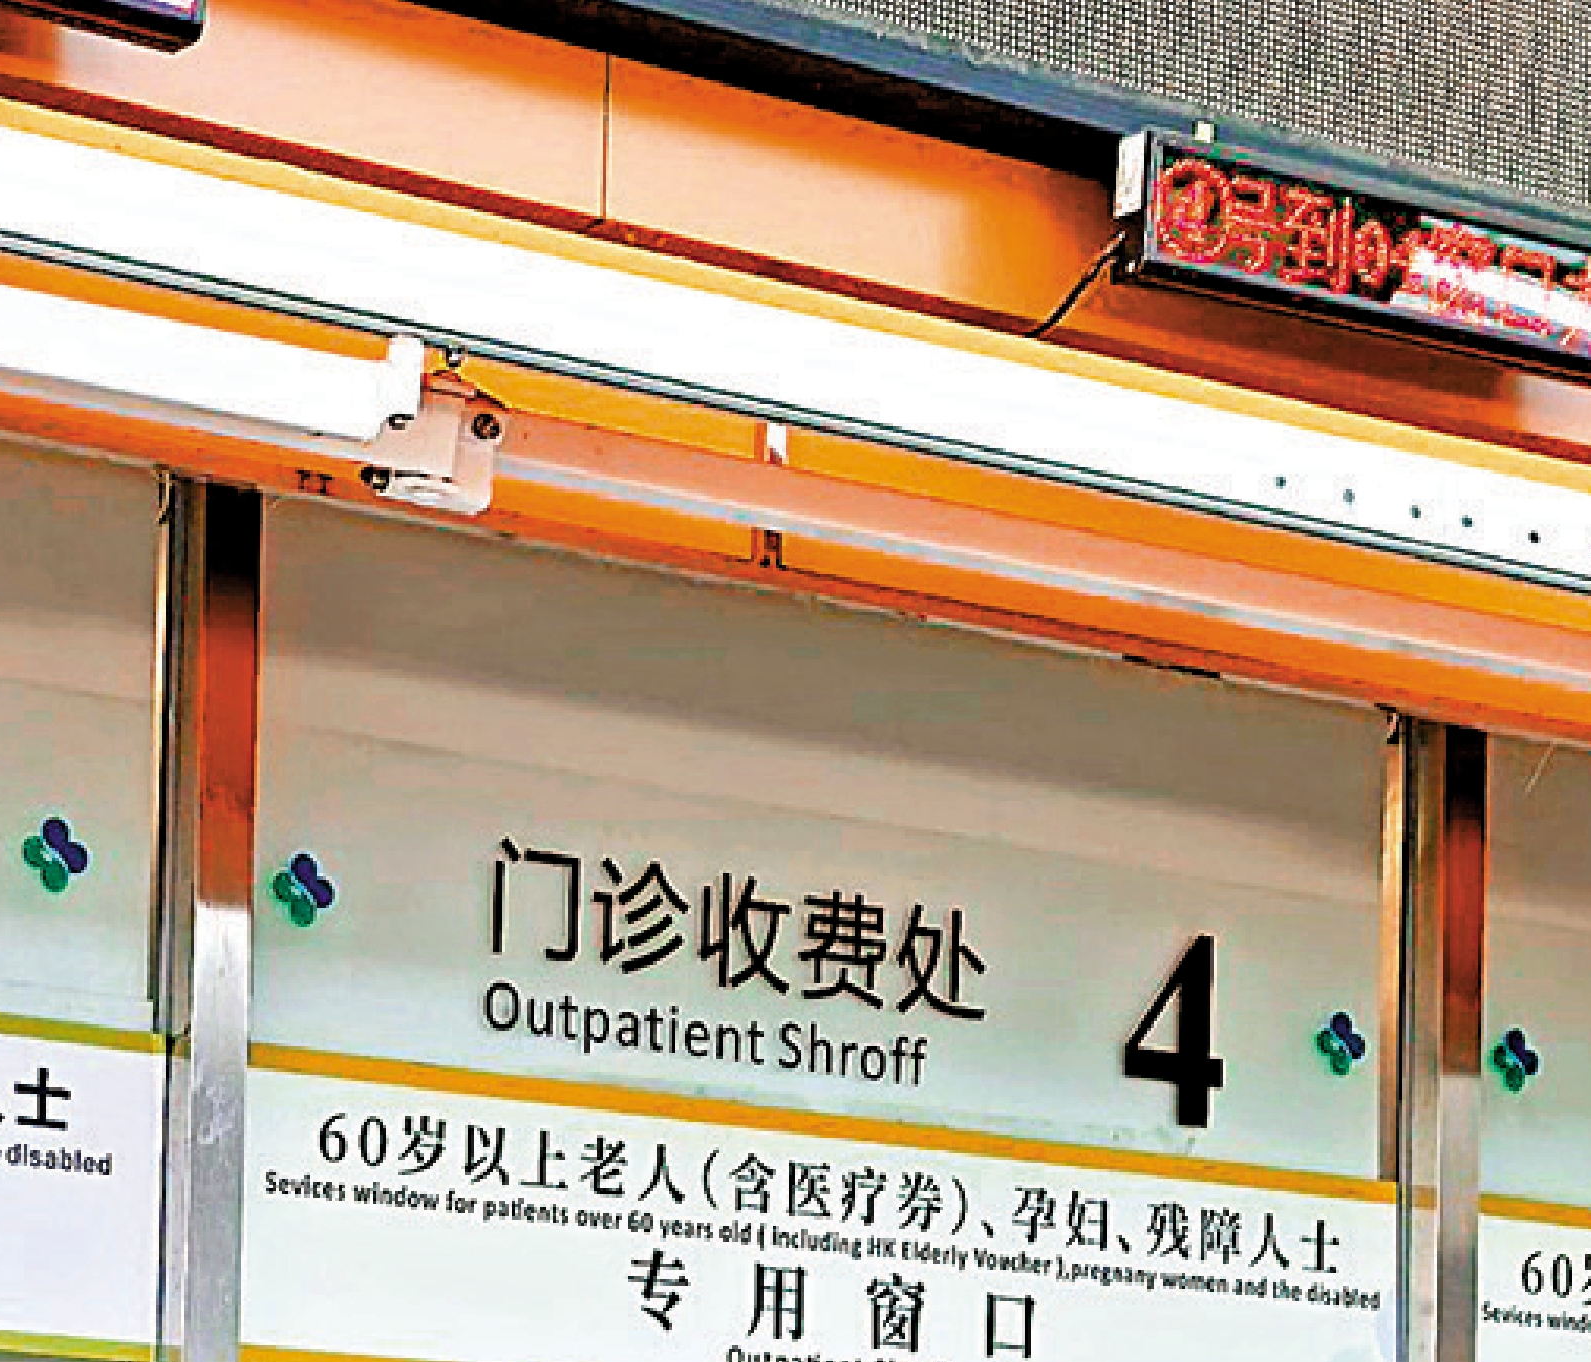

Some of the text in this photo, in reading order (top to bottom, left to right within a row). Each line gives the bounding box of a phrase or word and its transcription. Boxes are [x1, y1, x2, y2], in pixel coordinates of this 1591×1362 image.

[493, 836, 984, 1021] 门诊收费处
[484, 980, 927, 1087] Outpatient Shroff
[1119, 936, 1223, 1128] 4
[1, 1144, 112, 1175] disabled
[628, 1248, 1037, 1359] 专用窗口
